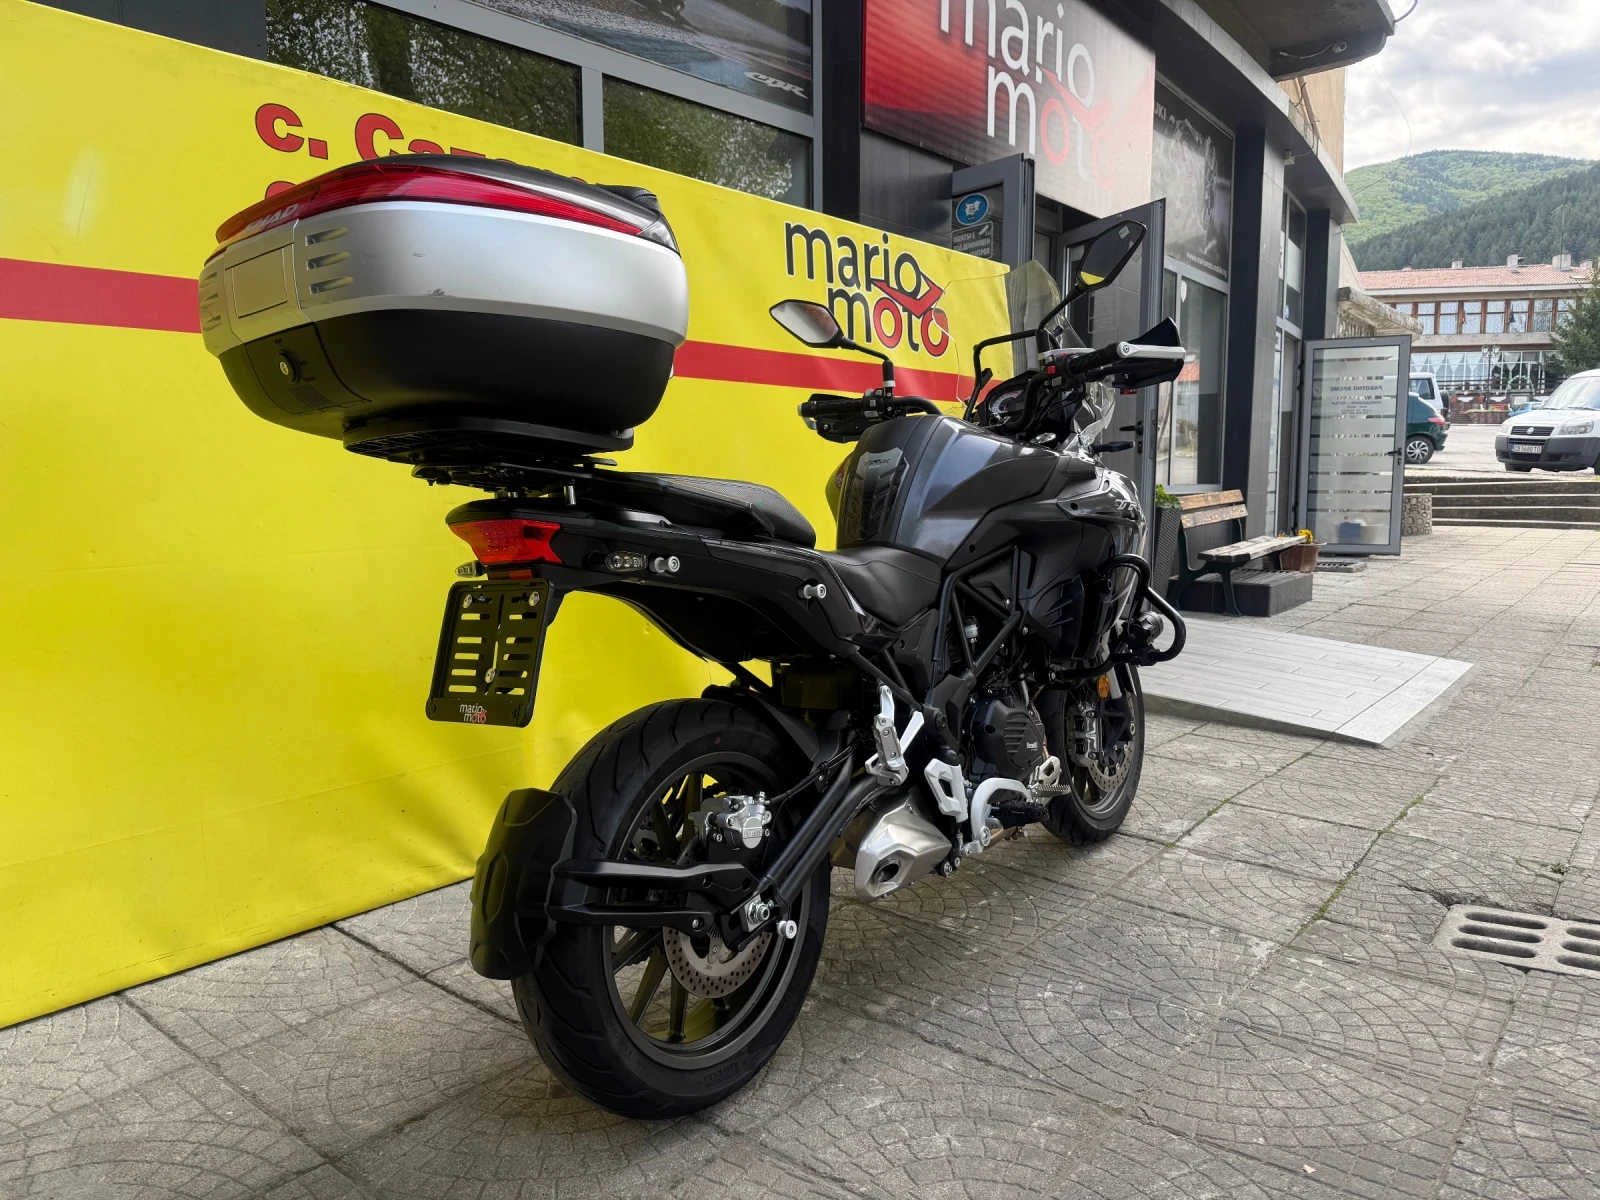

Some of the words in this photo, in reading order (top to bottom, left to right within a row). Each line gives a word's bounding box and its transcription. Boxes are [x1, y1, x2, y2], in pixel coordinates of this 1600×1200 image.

[743, 71, 810, 100] CBR
[987, 65, 1117, 189] moto
[785, 221, 923, 300] mario
[827, 286, 950, 358] moto
[459, 702, 483, 714] mario
[463, 713, 487, 724] moto
